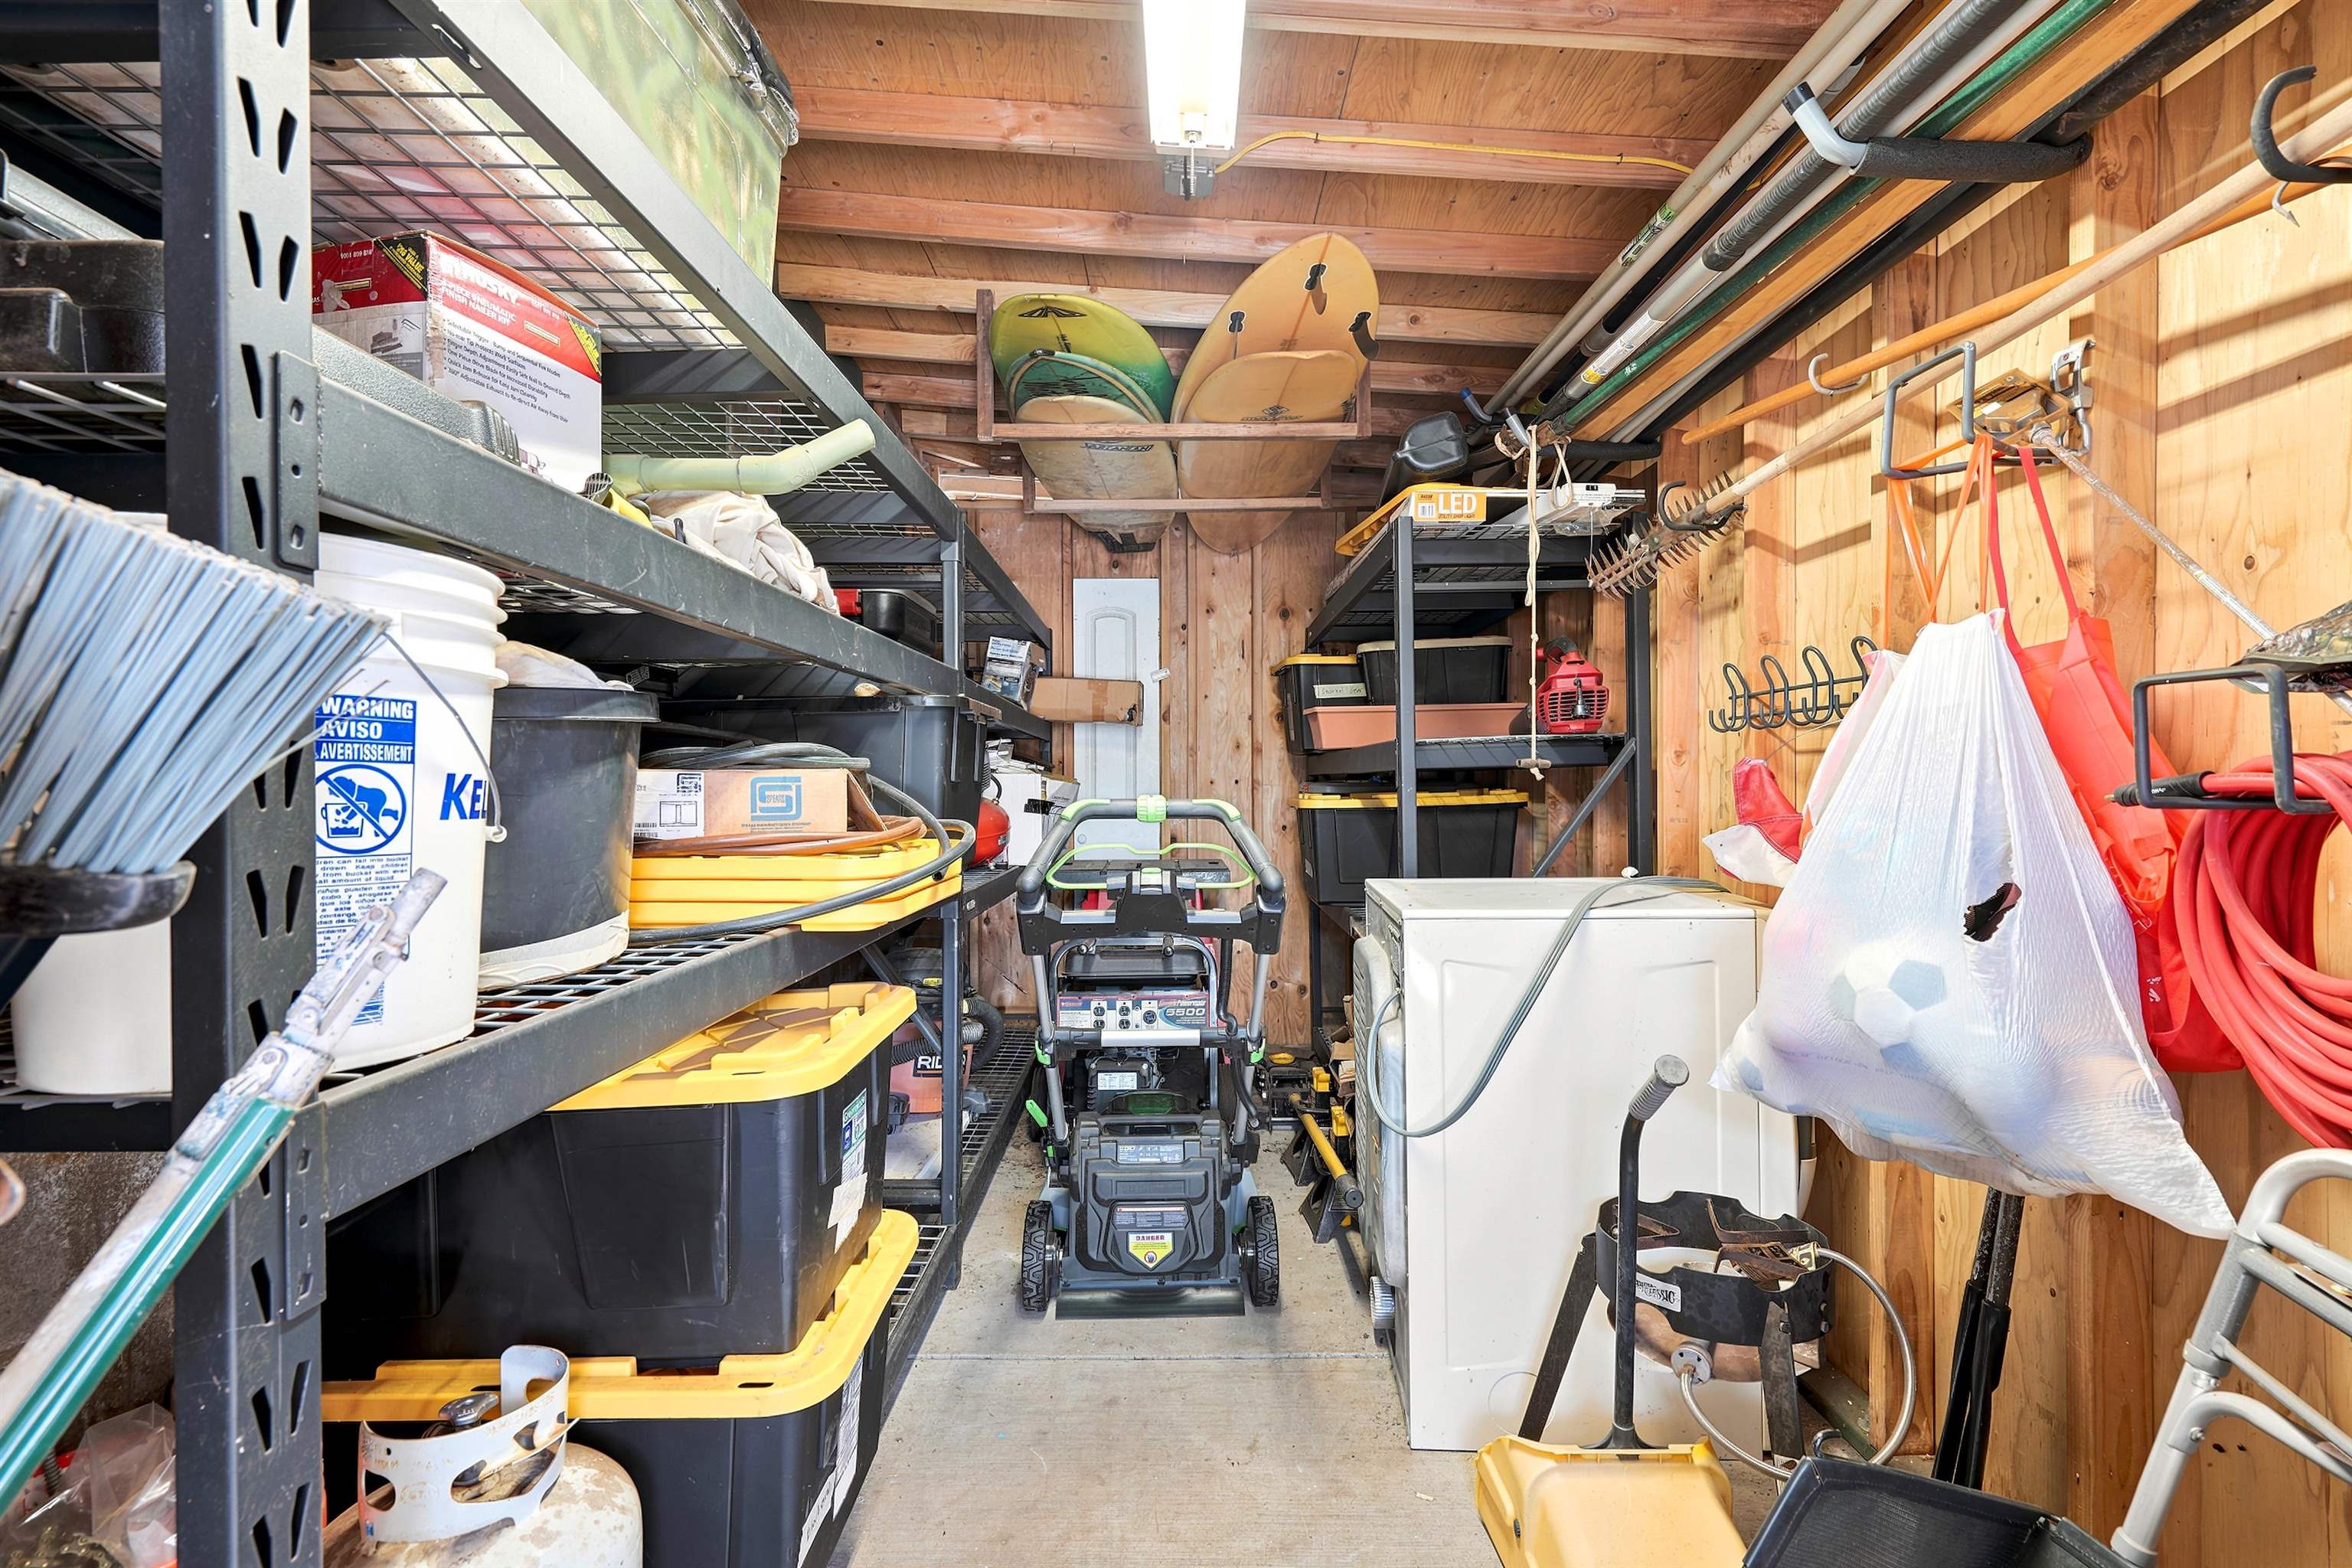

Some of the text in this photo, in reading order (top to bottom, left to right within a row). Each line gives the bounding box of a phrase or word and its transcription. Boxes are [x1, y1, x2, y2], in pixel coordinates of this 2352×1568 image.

[405, 252, 425, 273] VALUE
[457, 260, 519, 305] HUSKY
[479, 353, 505, 371] Adjustment
[495, 351, 505, 361] Work
[460, 371, 485, 390] Adjustable
[550, 410, 559, 420] from
[507, 374, 527, 388] Increased
[528, 384, 547, 399] Durability
[1439, 493, 1477, 514] LED
[322, 697, 413, 720] WARNING
[322, 720, 383, 740] AVISO
[320, 743, 413, 762] AVERTISSEMENT
